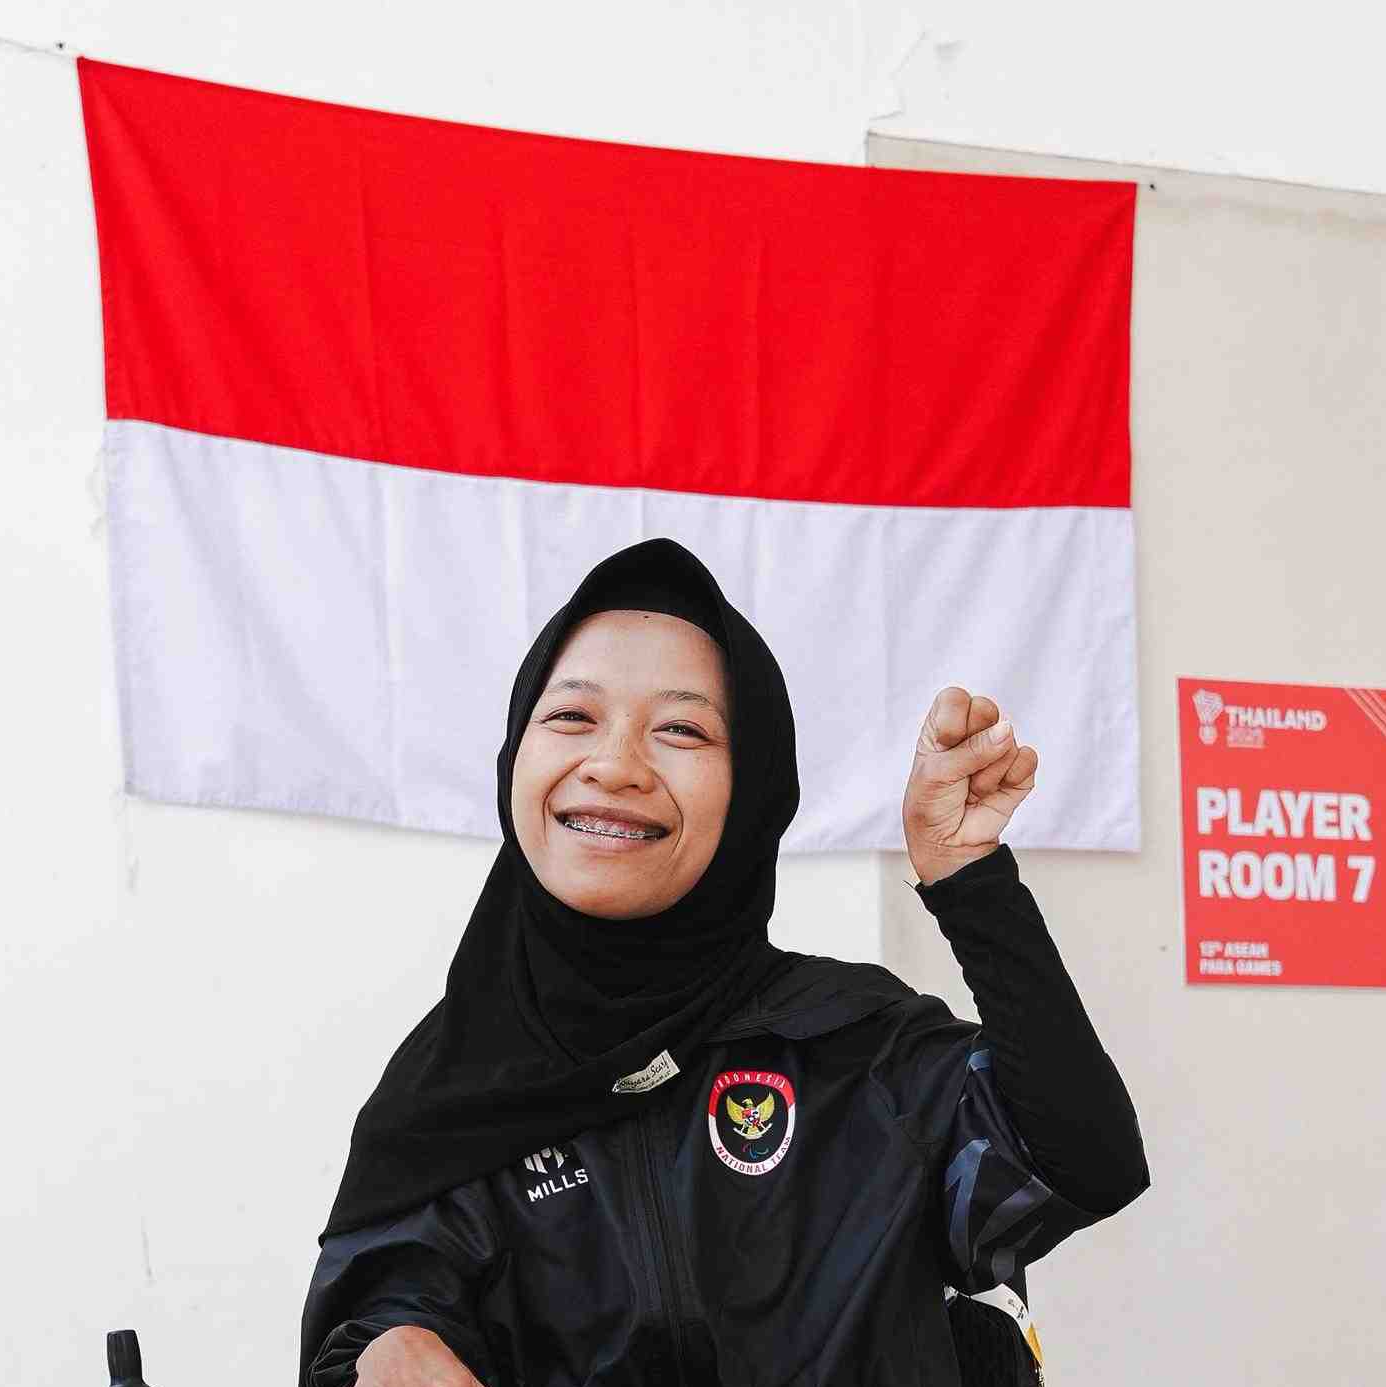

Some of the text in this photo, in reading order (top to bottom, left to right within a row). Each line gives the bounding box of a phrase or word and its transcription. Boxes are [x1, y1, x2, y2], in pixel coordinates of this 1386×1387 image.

[1225, 705, 1326, 731] THAILAND
[1197, 787, 1372, 841] PLAYER
[1199, 850, 1375, 903] ROOM 7
[714, 1073, 786, 1093] INDONESIA
[716, 1136, 791, 1173] NATIONAL TEAM
[527, 1168, 589, 1202] MILLS
